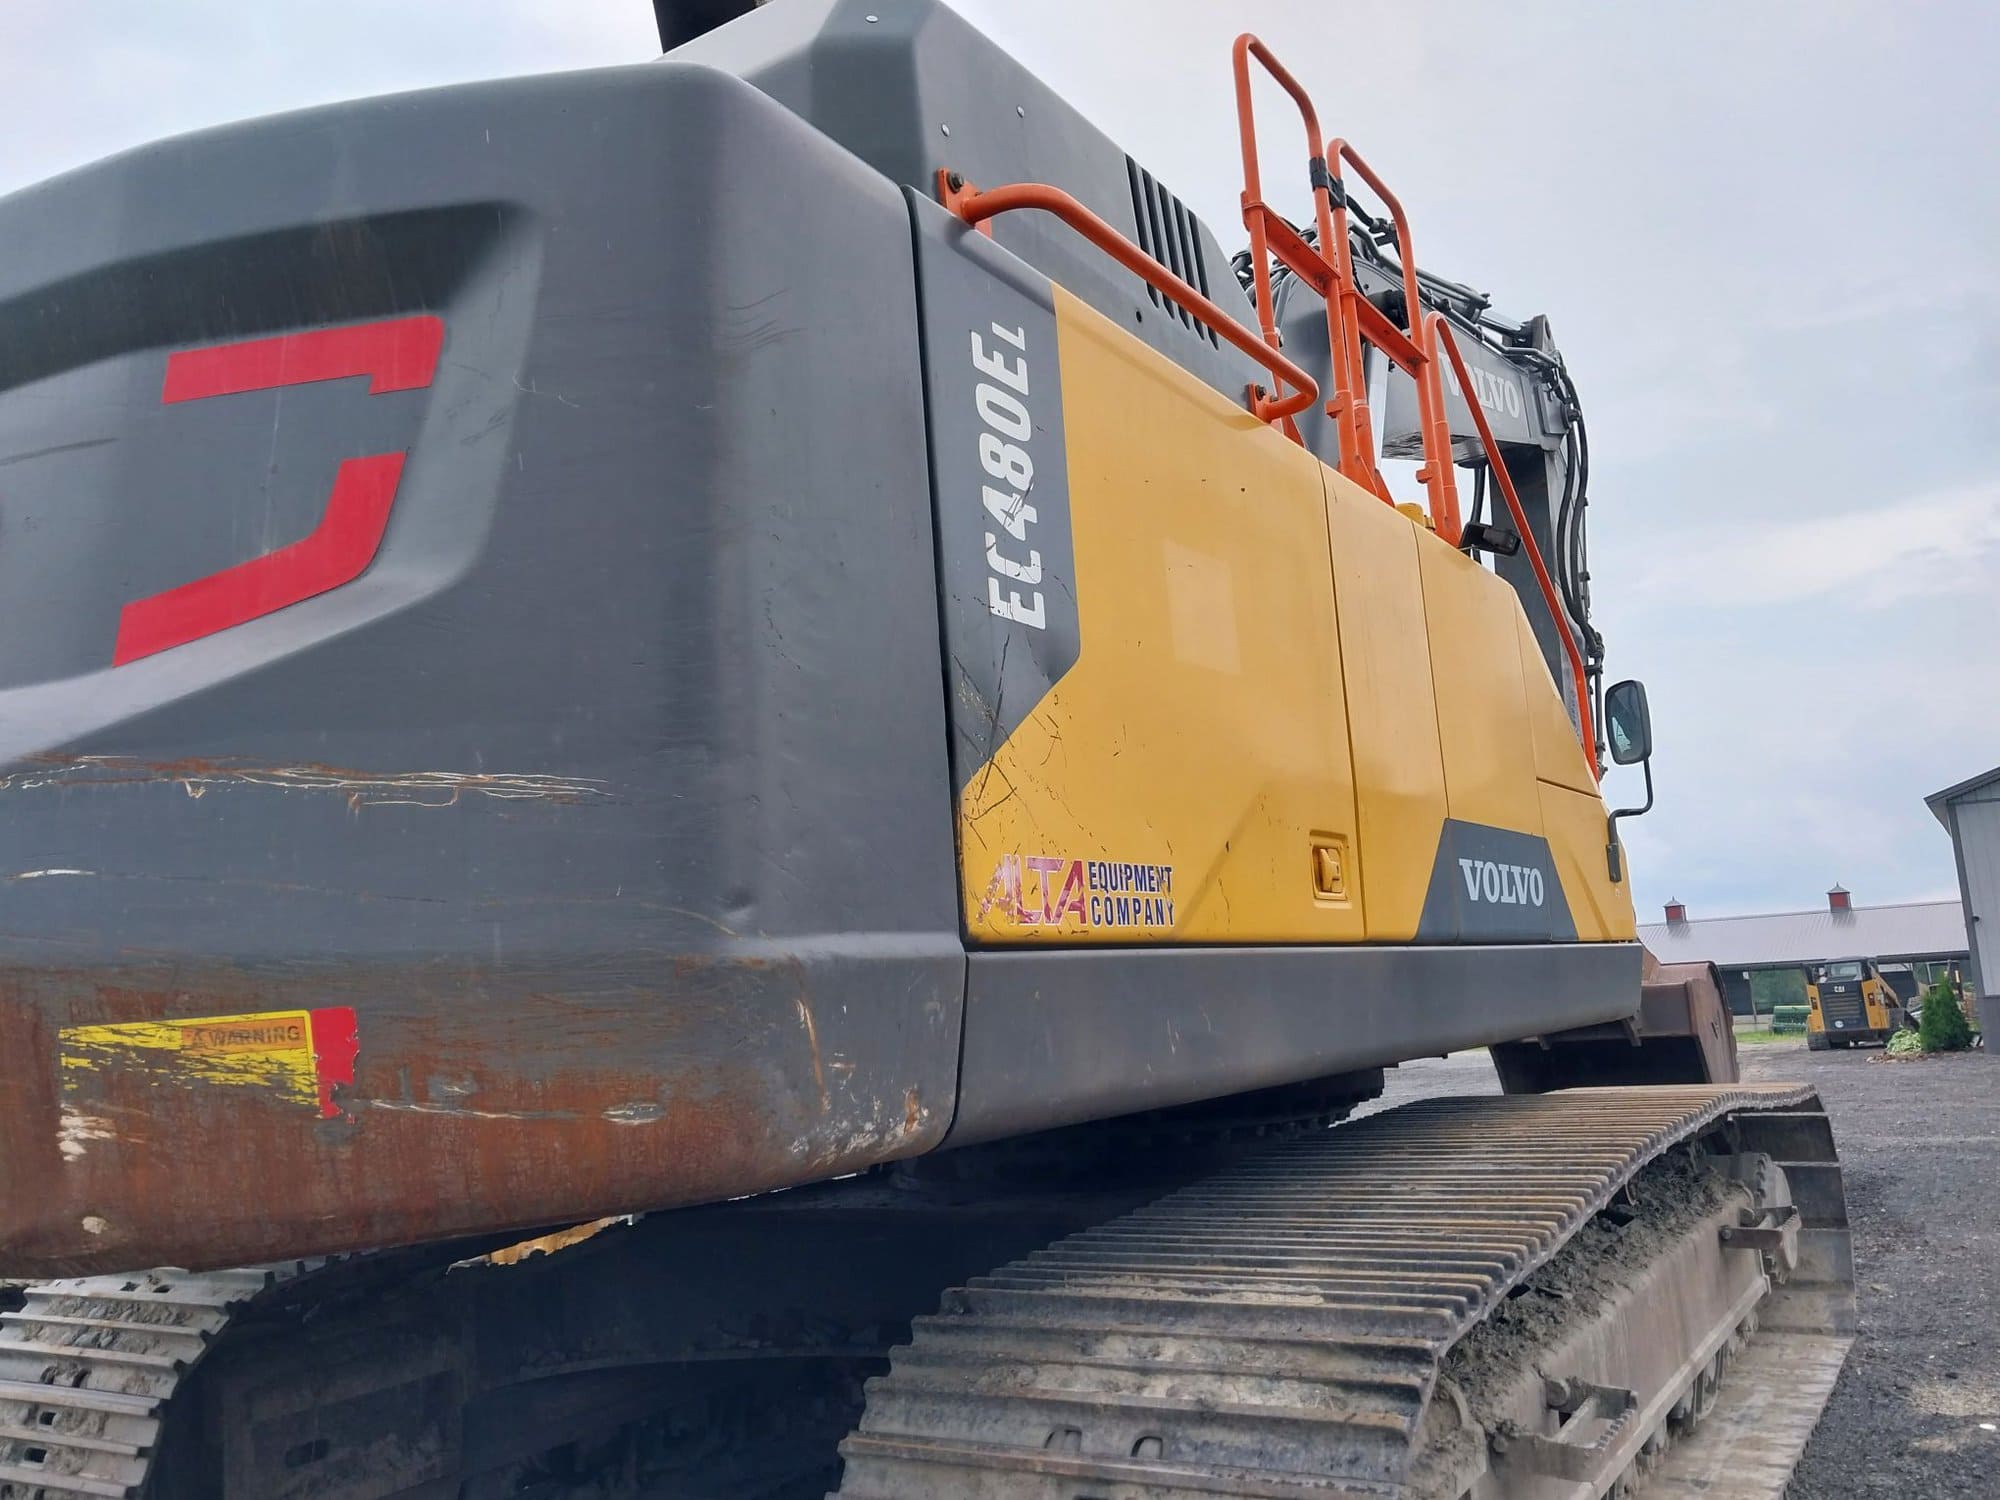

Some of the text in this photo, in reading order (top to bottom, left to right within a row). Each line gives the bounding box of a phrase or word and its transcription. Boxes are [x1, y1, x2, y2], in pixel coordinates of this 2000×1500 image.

[976, 854, 1087, 925] ALTA
[1088, 861, 1172, 894] EQUIPMENT
[1458, 858, 1544, 906] VOLVO
[1090, 896, 1174, 926] COMPANY
[208, 1025, 300, 1047] WARNING
